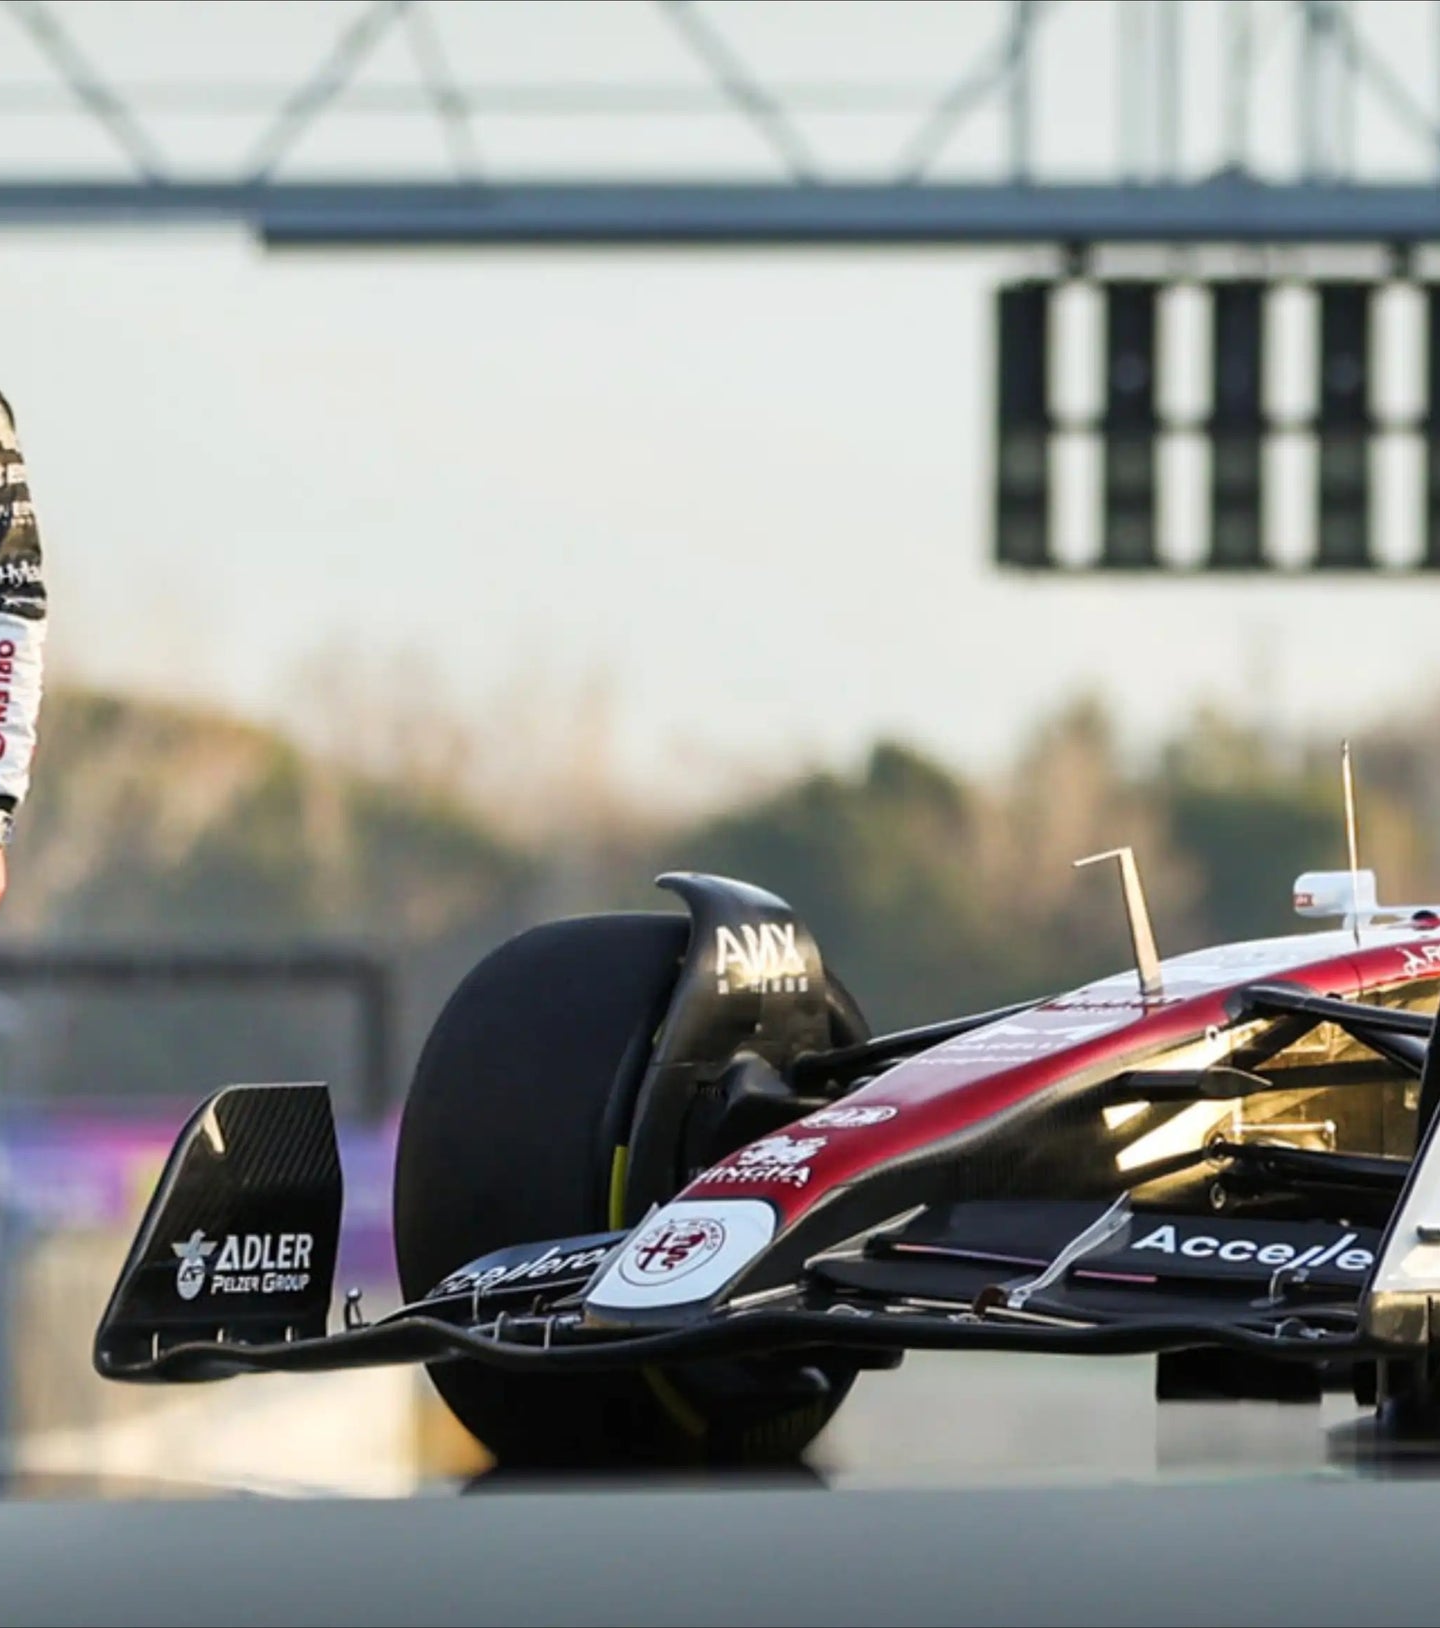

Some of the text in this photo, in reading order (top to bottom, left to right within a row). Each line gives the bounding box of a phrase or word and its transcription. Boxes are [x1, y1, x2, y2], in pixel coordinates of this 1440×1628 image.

[214, 1233, 314, 1271] ADLER
[1130, 1224, 1374, 1272] Accelle
[210, 1274, 260, 1296] PELZER
[262, 1272, 311, 1293] GROUP
